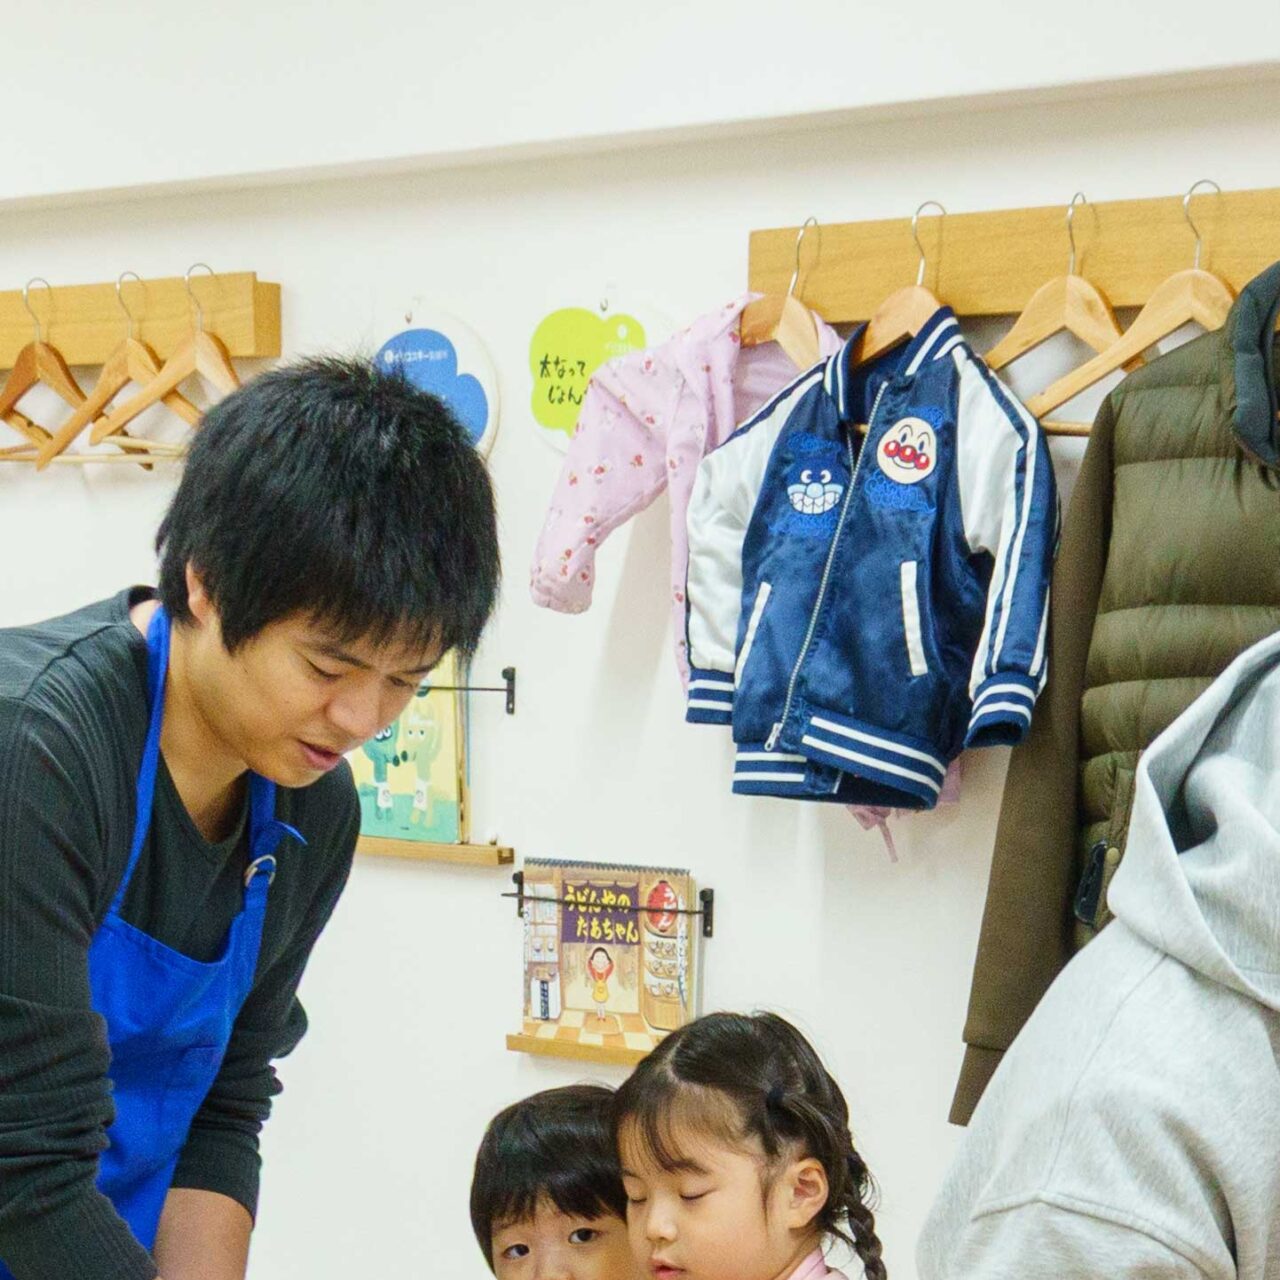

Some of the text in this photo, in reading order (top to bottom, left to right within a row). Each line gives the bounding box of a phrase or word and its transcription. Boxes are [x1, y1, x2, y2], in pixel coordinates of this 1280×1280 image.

[548, 385, 588, 405] じょん
[564, 885, 631, 913] うどんやの
[576, 916, 639, 943] たあちゃん
